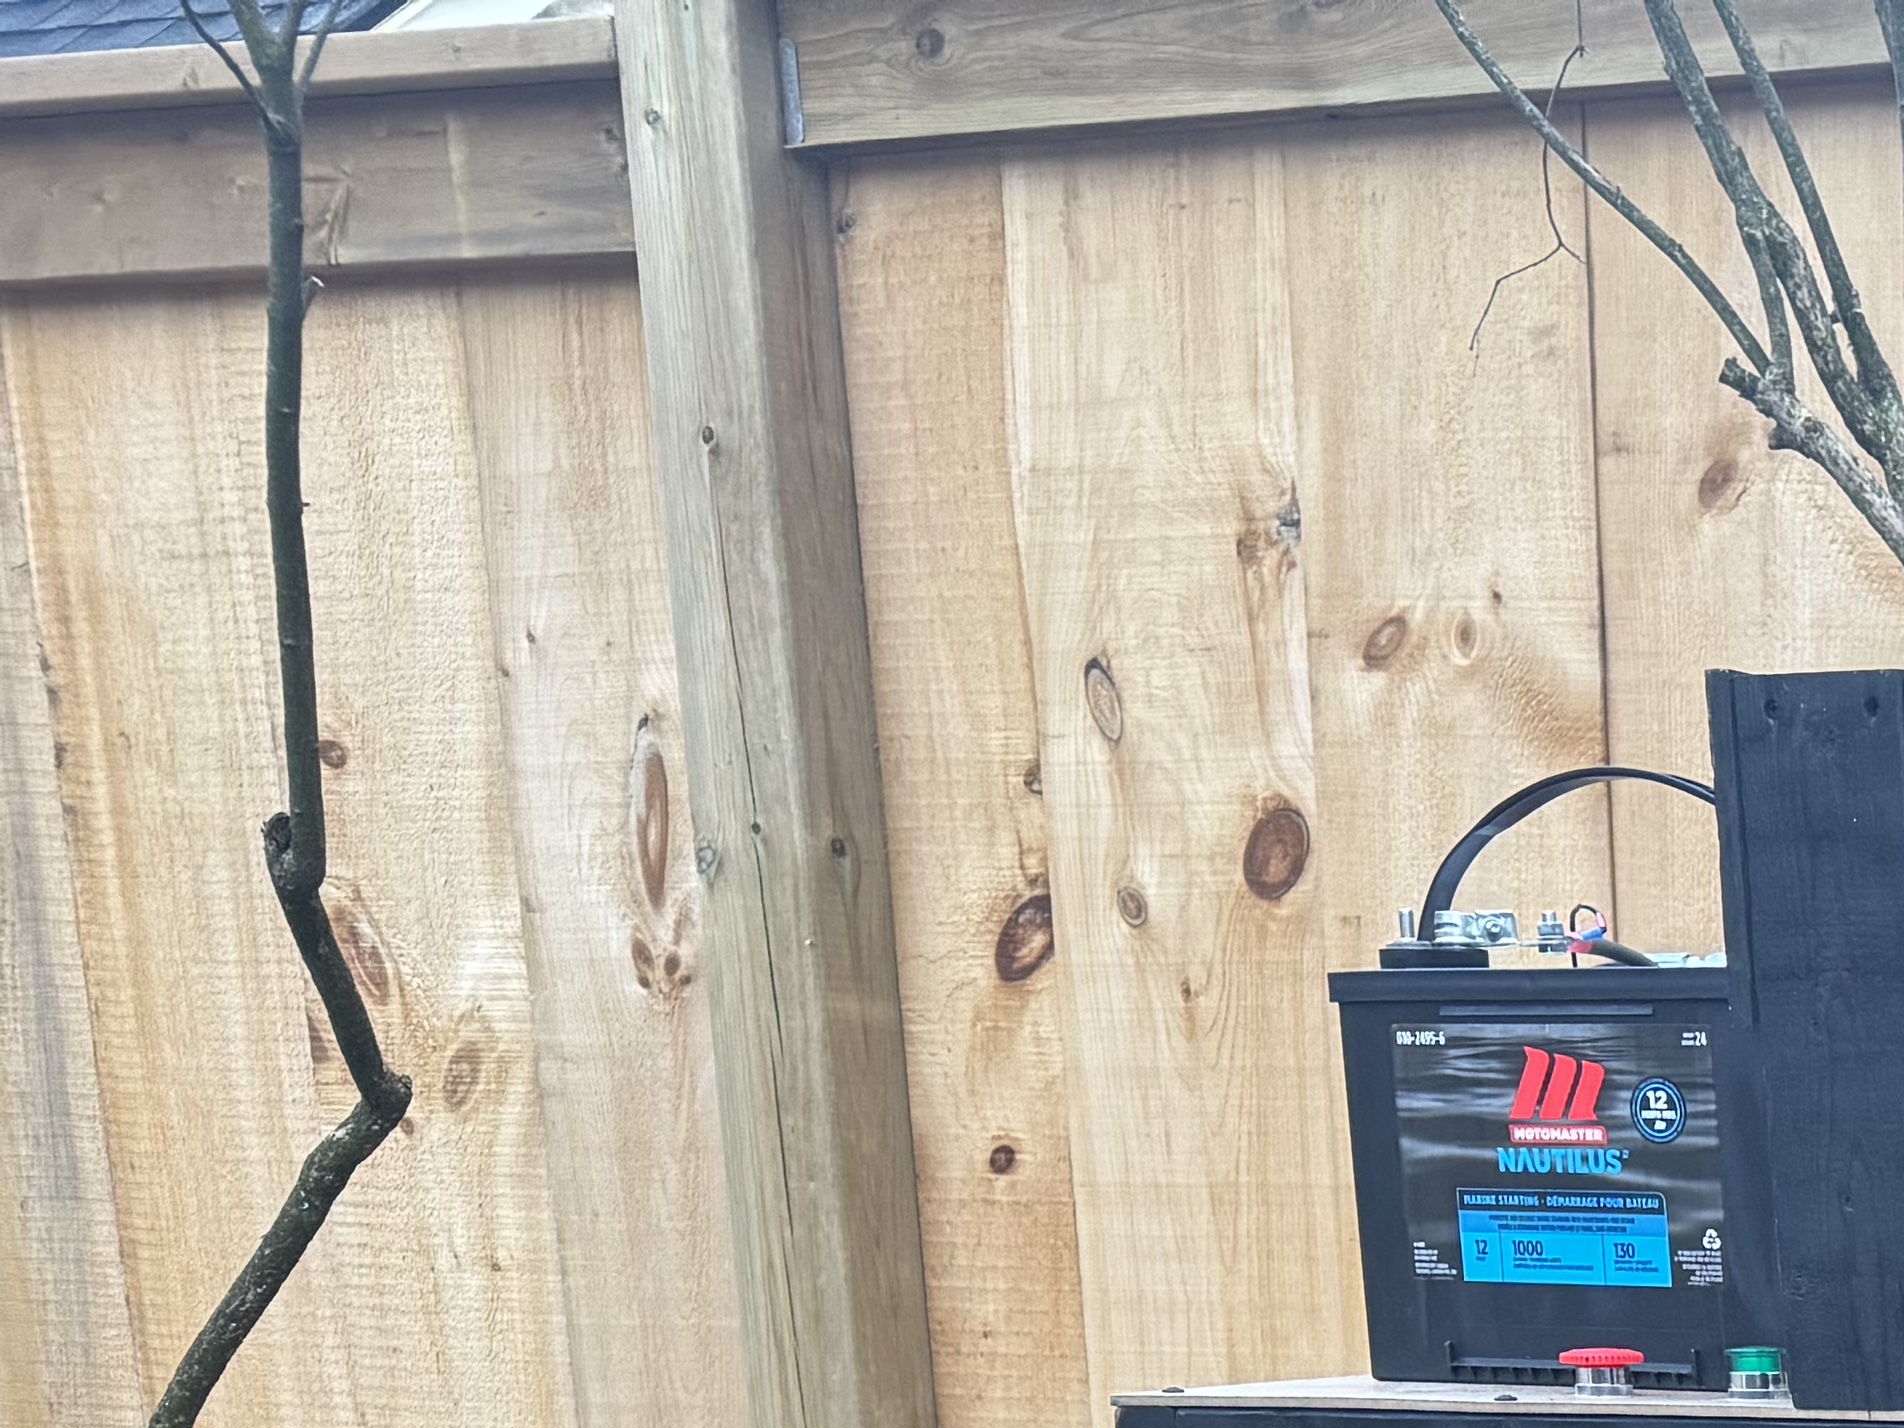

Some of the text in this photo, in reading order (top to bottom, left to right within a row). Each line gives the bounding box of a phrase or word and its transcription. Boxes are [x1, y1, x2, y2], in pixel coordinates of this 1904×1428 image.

[1646, 1090, 1668, 1110] 12
[1514, 1127, 1603, 1141] MOTOMASTER
[1497, 1147, 1623, 1175] NAUTILUS
[1498, 1195, 1540, 1207] STARTING
[1600, 1197, 1624, 1208] POUR
[1475, 1239, 1488, 1255] 12
[1512, 1240, 1544, 1256] 1000
[1613, 1243, 1636, 1259] 130
